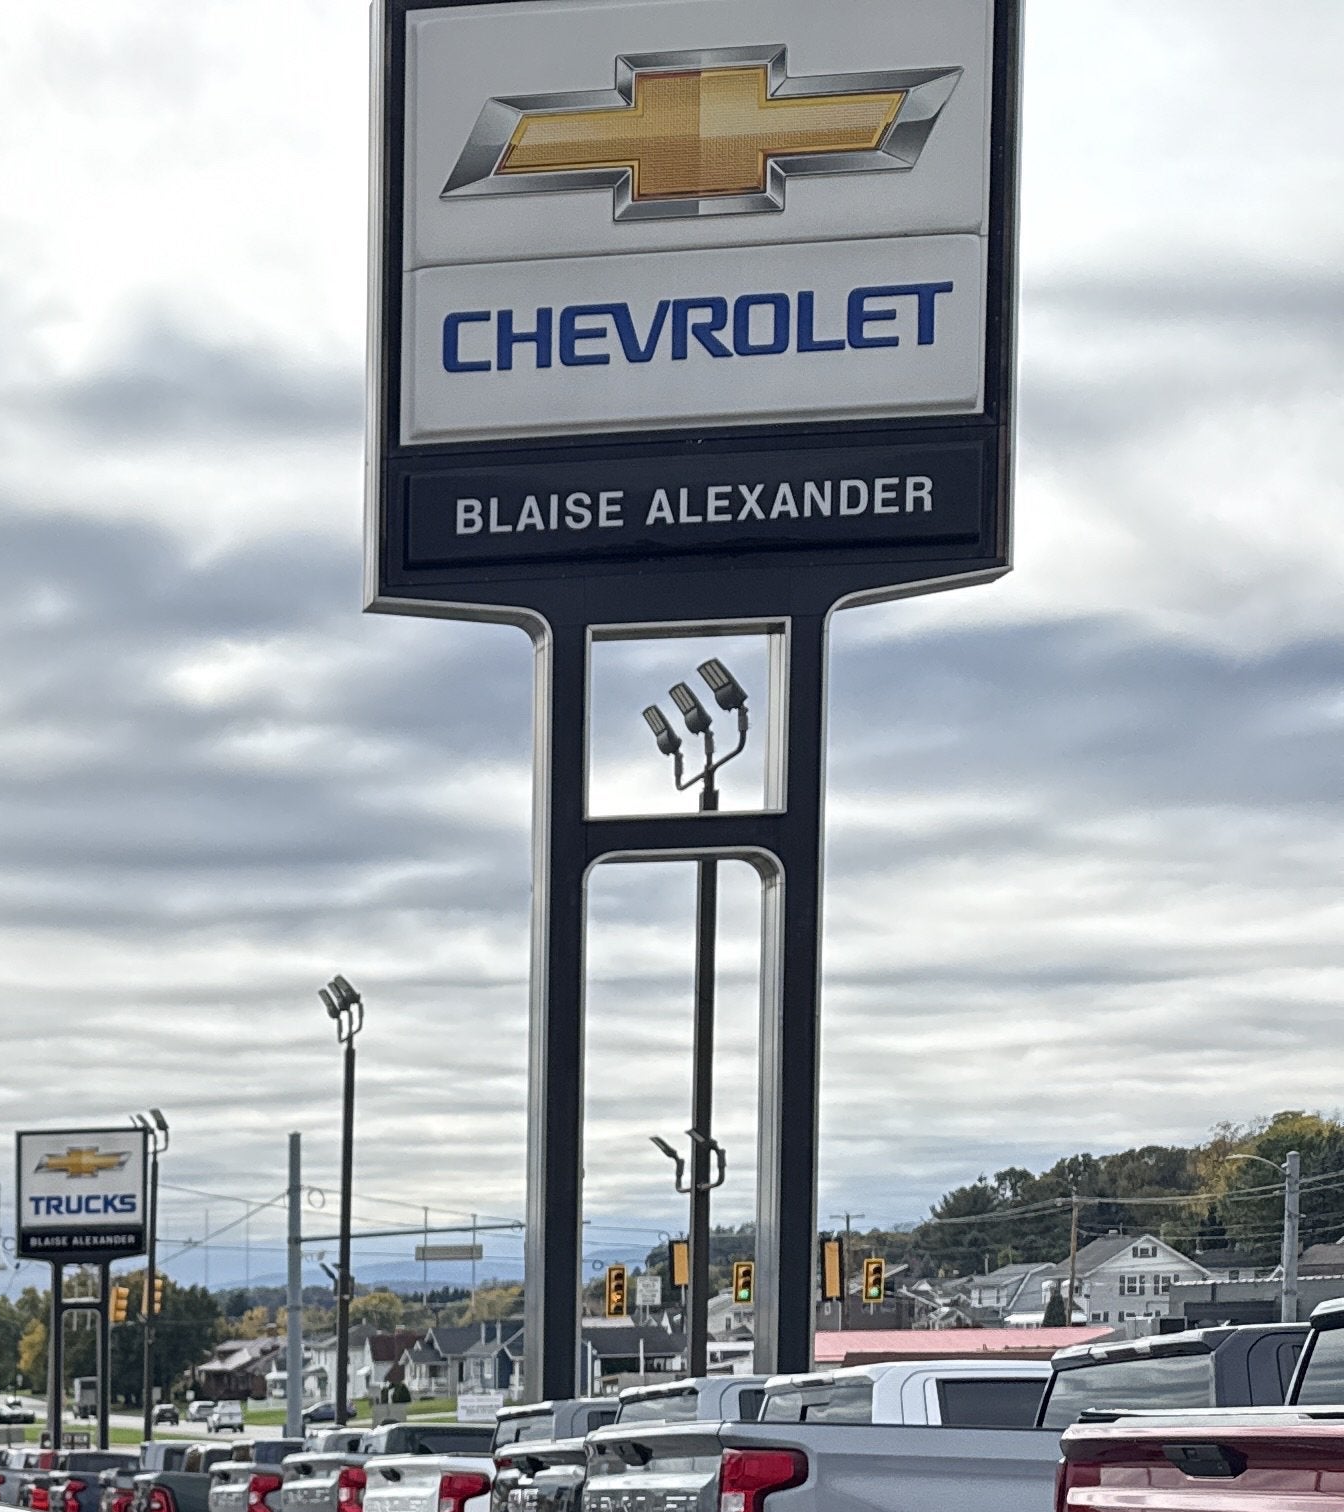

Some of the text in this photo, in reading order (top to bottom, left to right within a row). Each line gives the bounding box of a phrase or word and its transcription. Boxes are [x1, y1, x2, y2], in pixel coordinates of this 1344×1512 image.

[442, 281, 954, 373] CHEVROLET
[455, 475, 934, 536] BLAISE ALEXANDER
[29, 1194, 137, 1216] TRUCKS
[29, 1234, 136, 1248] BLAISE ALEXANDER
